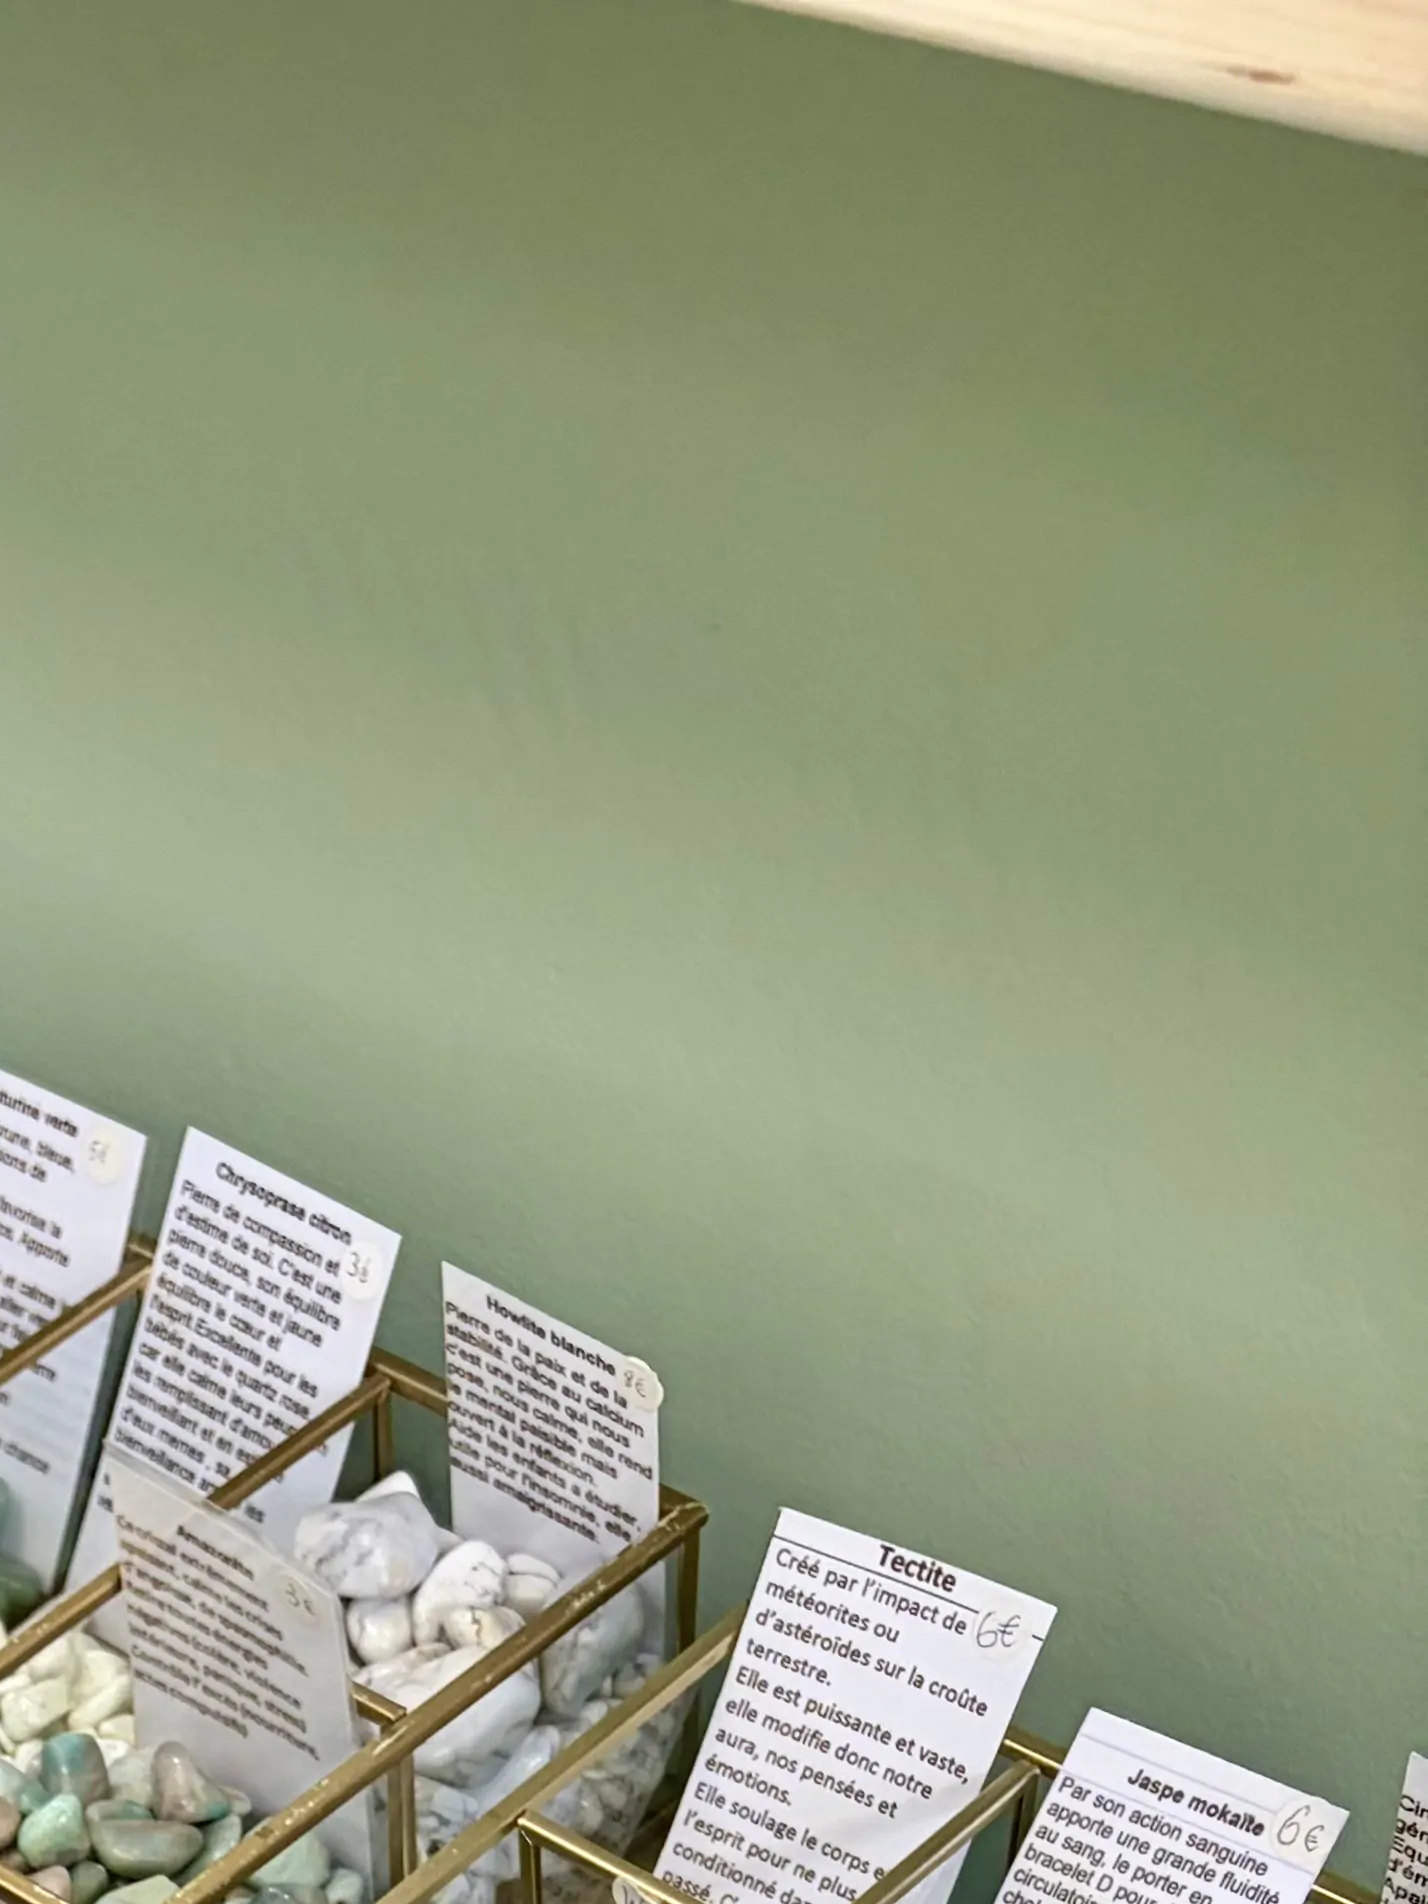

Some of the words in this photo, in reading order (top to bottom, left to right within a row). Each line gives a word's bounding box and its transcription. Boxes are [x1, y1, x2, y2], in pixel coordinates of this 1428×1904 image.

[550, 1330, 616, 1376] blanche
[776, 1548, 820, 1579] Créé
[823, 1570, 859, 1592] par
[861, 1577, 940, 1624] l'impact
[942, 1611, 967, 1636] de
[879, 1544, 957, 1593] Tectite
[765, 1581, 870, 1632] météorites
[873, 1623, 900, 1643] ou
[975, 1611, 1022, 1649] 6€
[746, 1638, 831, 1687] terrestre.
[755, 1608, 872, 1667] d'astéroïdes
[874, 1658, 906, 1680] sur
[907, 1666, 925, 1690] la
[928, 1680, 988, 1717] croûte
[1127, 1768, 1185, 1804] Jaspe
[1046, 1802, 1114, 1840] apporte
[1116, 1830, 1151, 1855] une
[1151, 1847, 1217, 1883] grande
[1058, 1775, 1092, 1802] Par
[1092, 1794, 1126, 1818] son
[1128, 1809, 1183, 1842] action
[1185, 1833, 1269, 1877] sanguine
[1276, 1804, 1326, 1853] 6€
